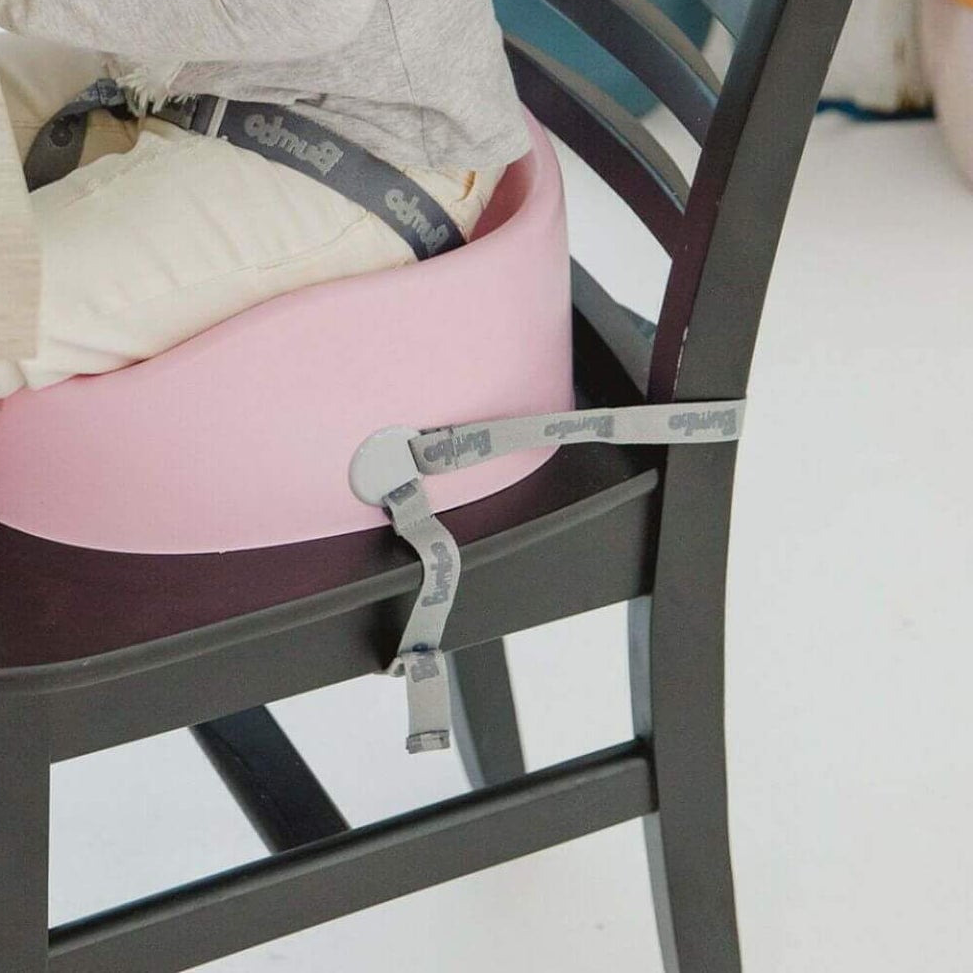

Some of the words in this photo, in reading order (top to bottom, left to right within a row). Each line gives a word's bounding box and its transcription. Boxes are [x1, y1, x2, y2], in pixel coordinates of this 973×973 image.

[244, 113, 344, 176] Bumbo
[543, 414, 615, 440] Bumbo
[667, 408, 737, 437] Bumbo
[423, 428, 492, 466] Bumbo
